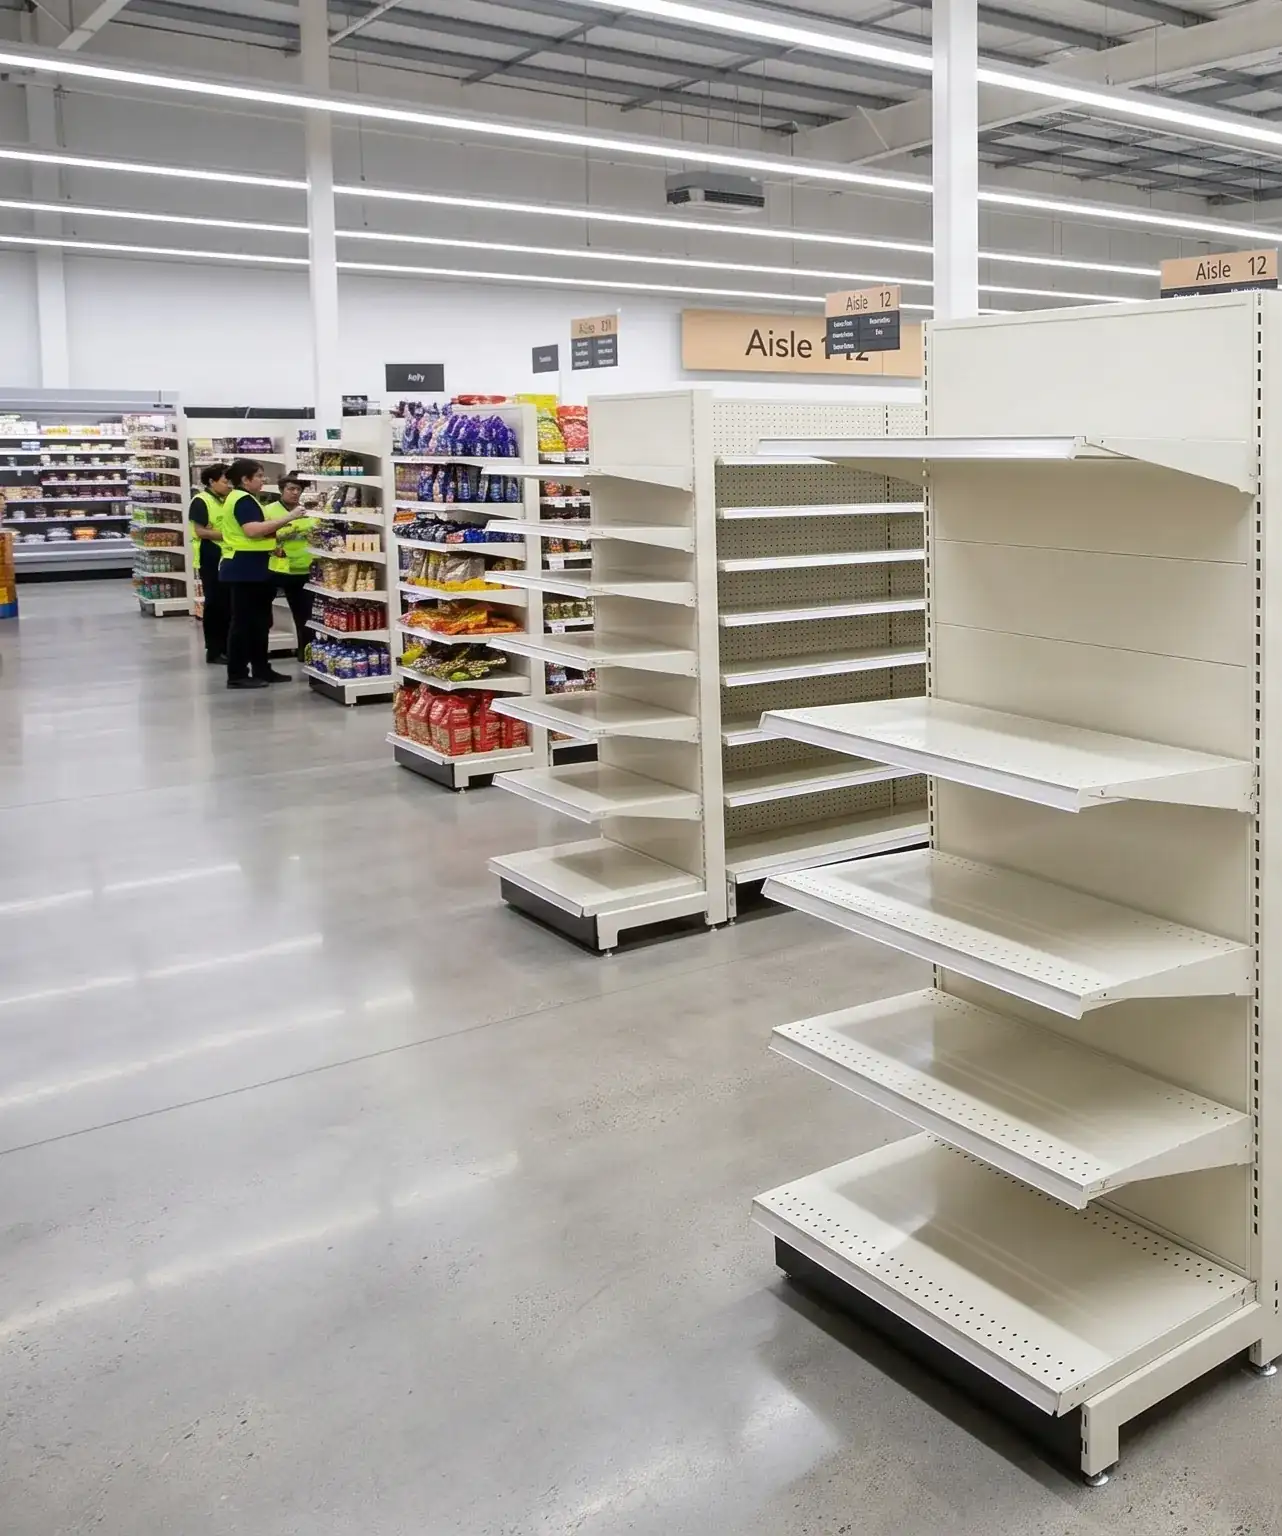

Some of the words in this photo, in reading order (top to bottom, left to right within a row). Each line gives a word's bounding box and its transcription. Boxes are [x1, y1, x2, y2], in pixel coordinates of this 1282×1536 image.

[1195, 259, 1231, 281] Aisle
[1247, 255, 1267, 276] 12
[845, 294, 868, 311] Aisle
[879, 291, 891, 308] 12
[745, 328, 813, 359] Aisle
